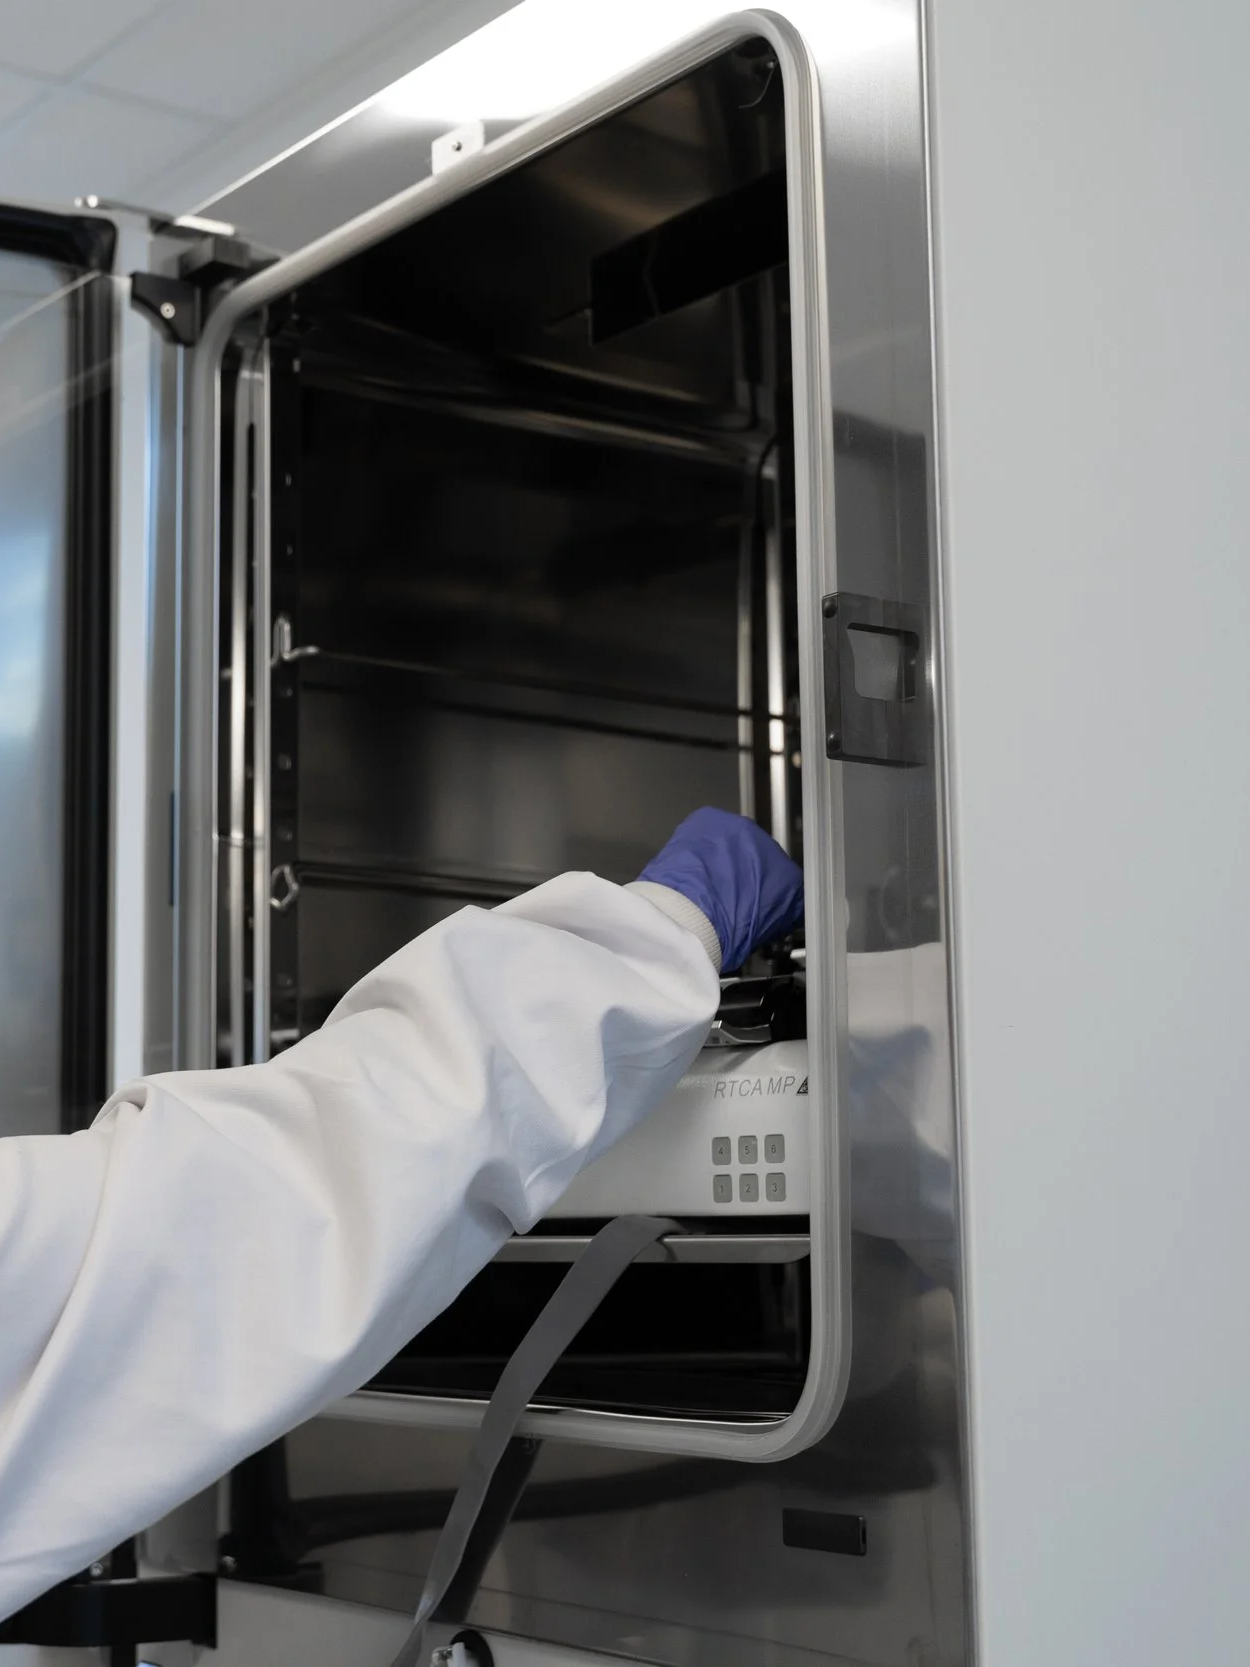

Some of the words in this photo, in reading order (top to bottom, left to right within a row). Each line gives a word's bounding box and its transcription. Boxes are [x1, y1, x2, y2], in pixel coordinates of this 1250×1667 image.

[767, 1076, 796, 1095] MP
[744, 1145, 750, 1155] 5
[770, 1144, 776, 1154] 6
[745, 1183, 751, 1193] 2
[772, 1182, 778, 1192] 3
